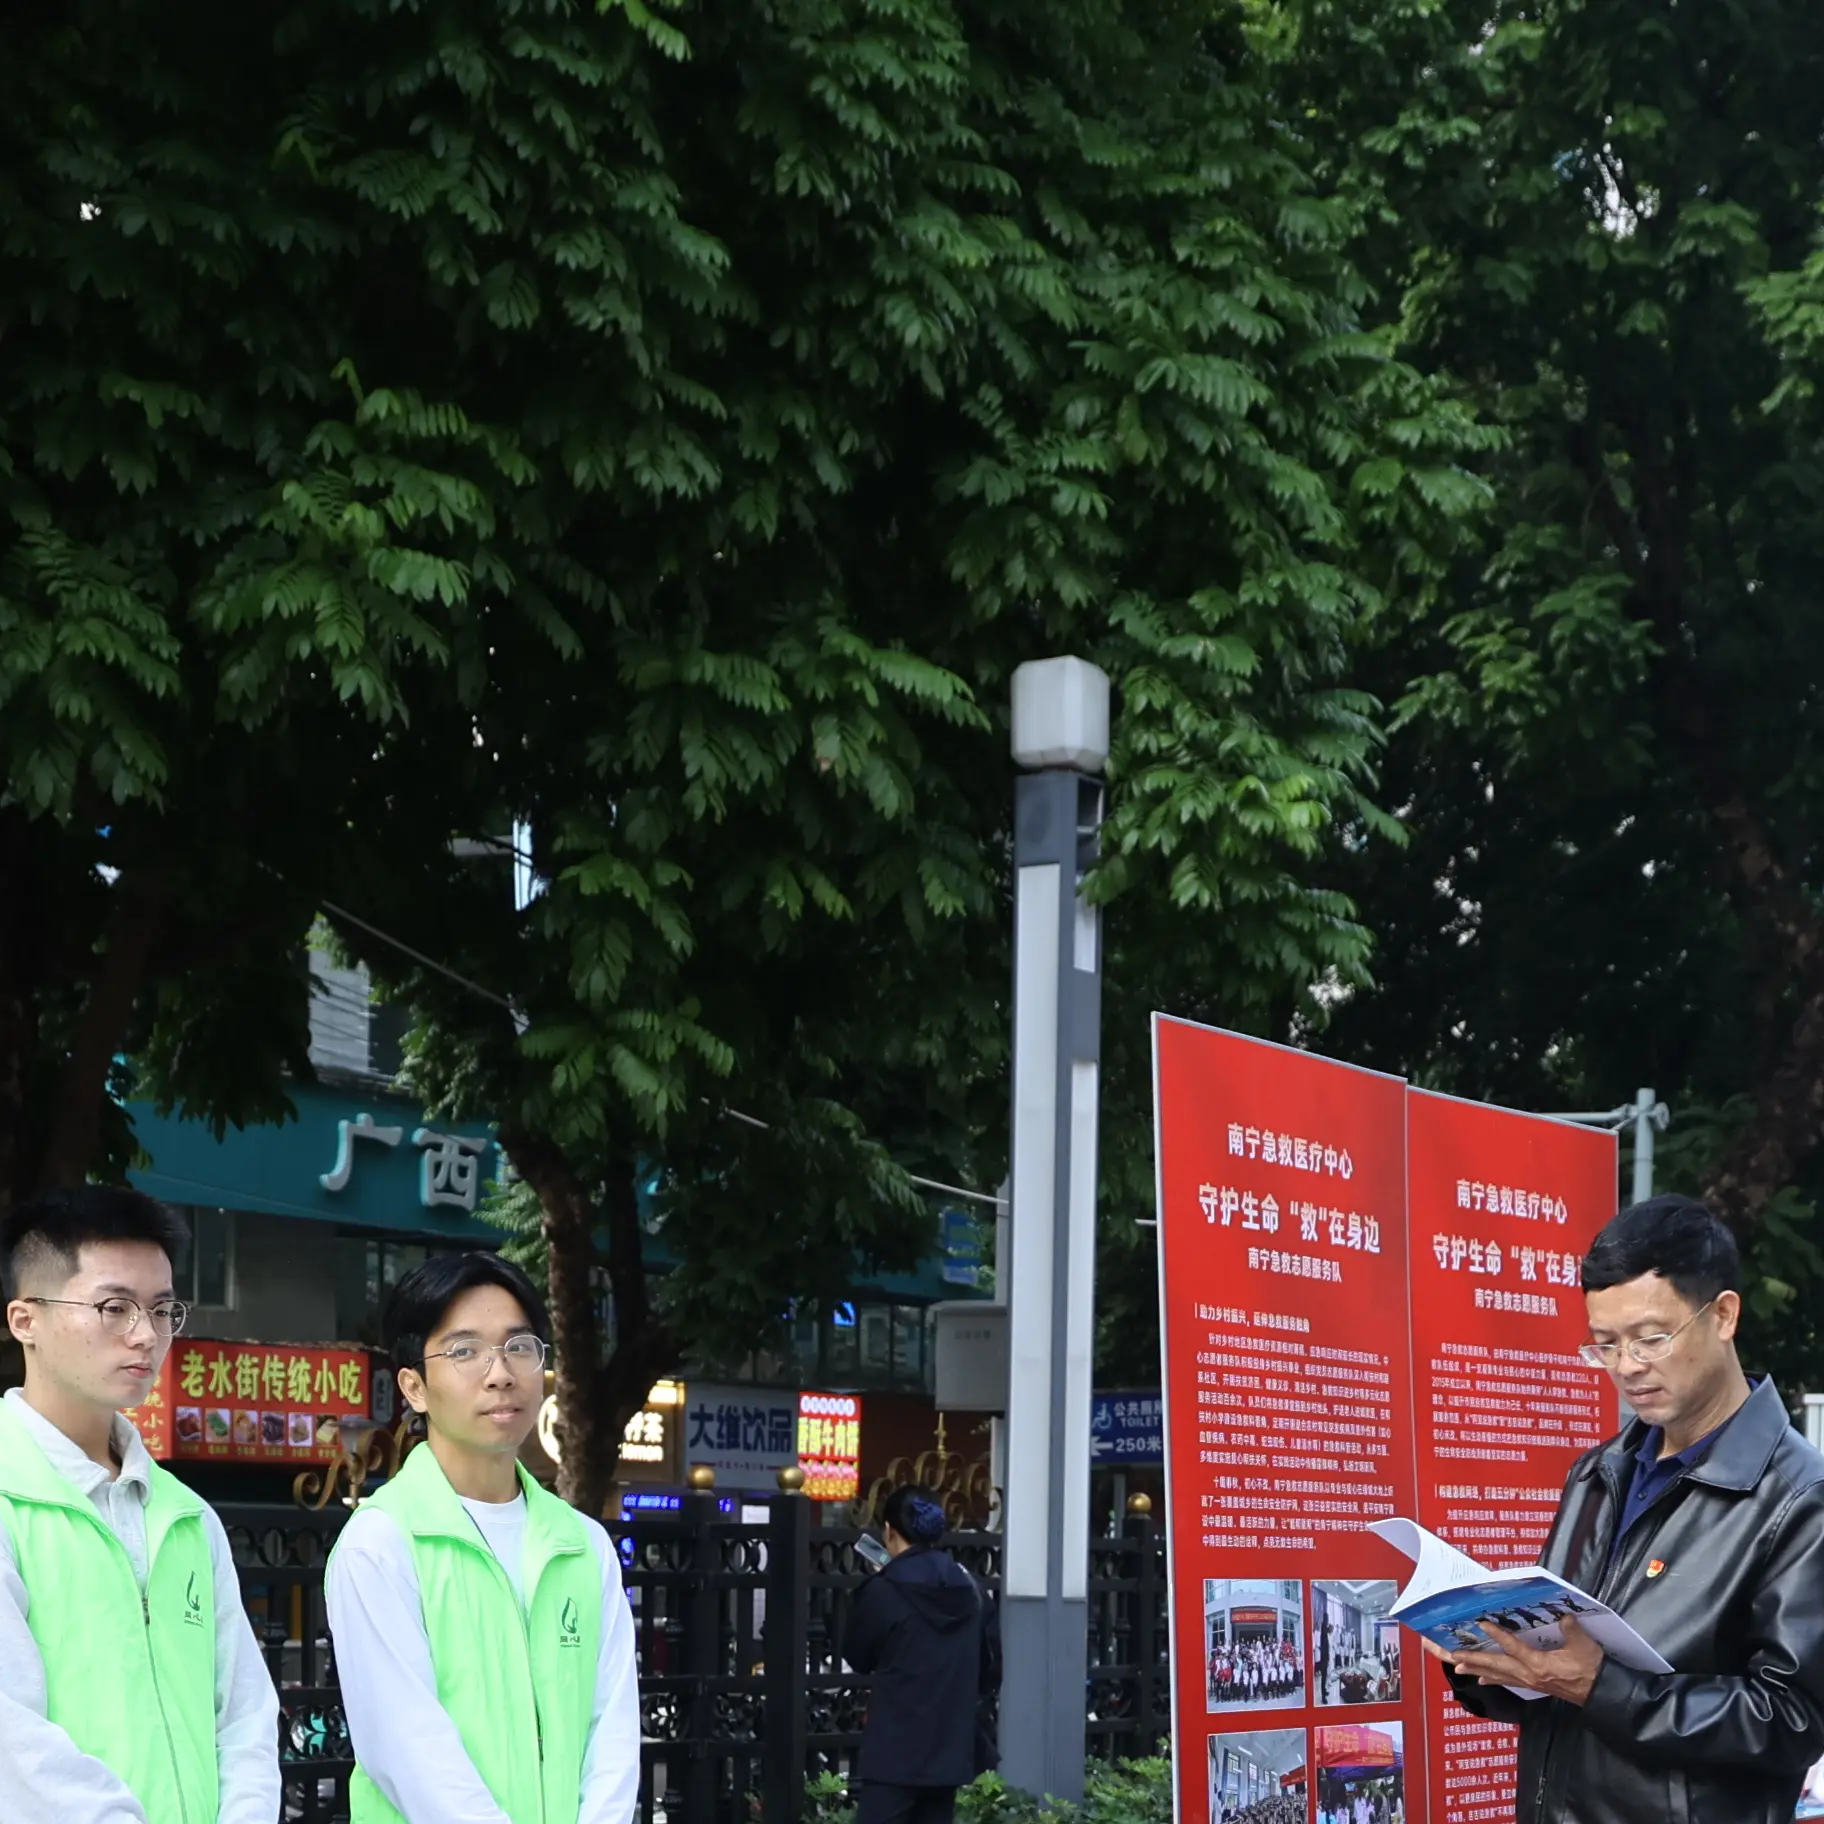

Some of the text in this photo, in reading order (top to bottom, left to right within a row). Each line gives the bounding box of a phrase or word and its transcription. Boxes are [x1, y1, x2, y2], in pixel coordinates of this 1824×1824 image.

[320, 1112, 486, 1212] 广西
[1228, 1122, 1353, 1180] 南宁急救医疗中心
[1199, 1182, 1280, 1235] 守护生命
[1456, 1178, 1567, 1224] 南宁急救医疗中心
[1248, 1246, 1342, 1283] 南宁急救志愿服务队
[1433, 1232, 1502, 1275] 守护生命
[1475, 1288, 1558, 1316] 南宁急救志愿服务队
[181, 1349, 362, 1405] 老水街传统小吃
[689, 1403, 792, 1453] 大维饮品
[1116, 1436, 1161, 1452] 250米
